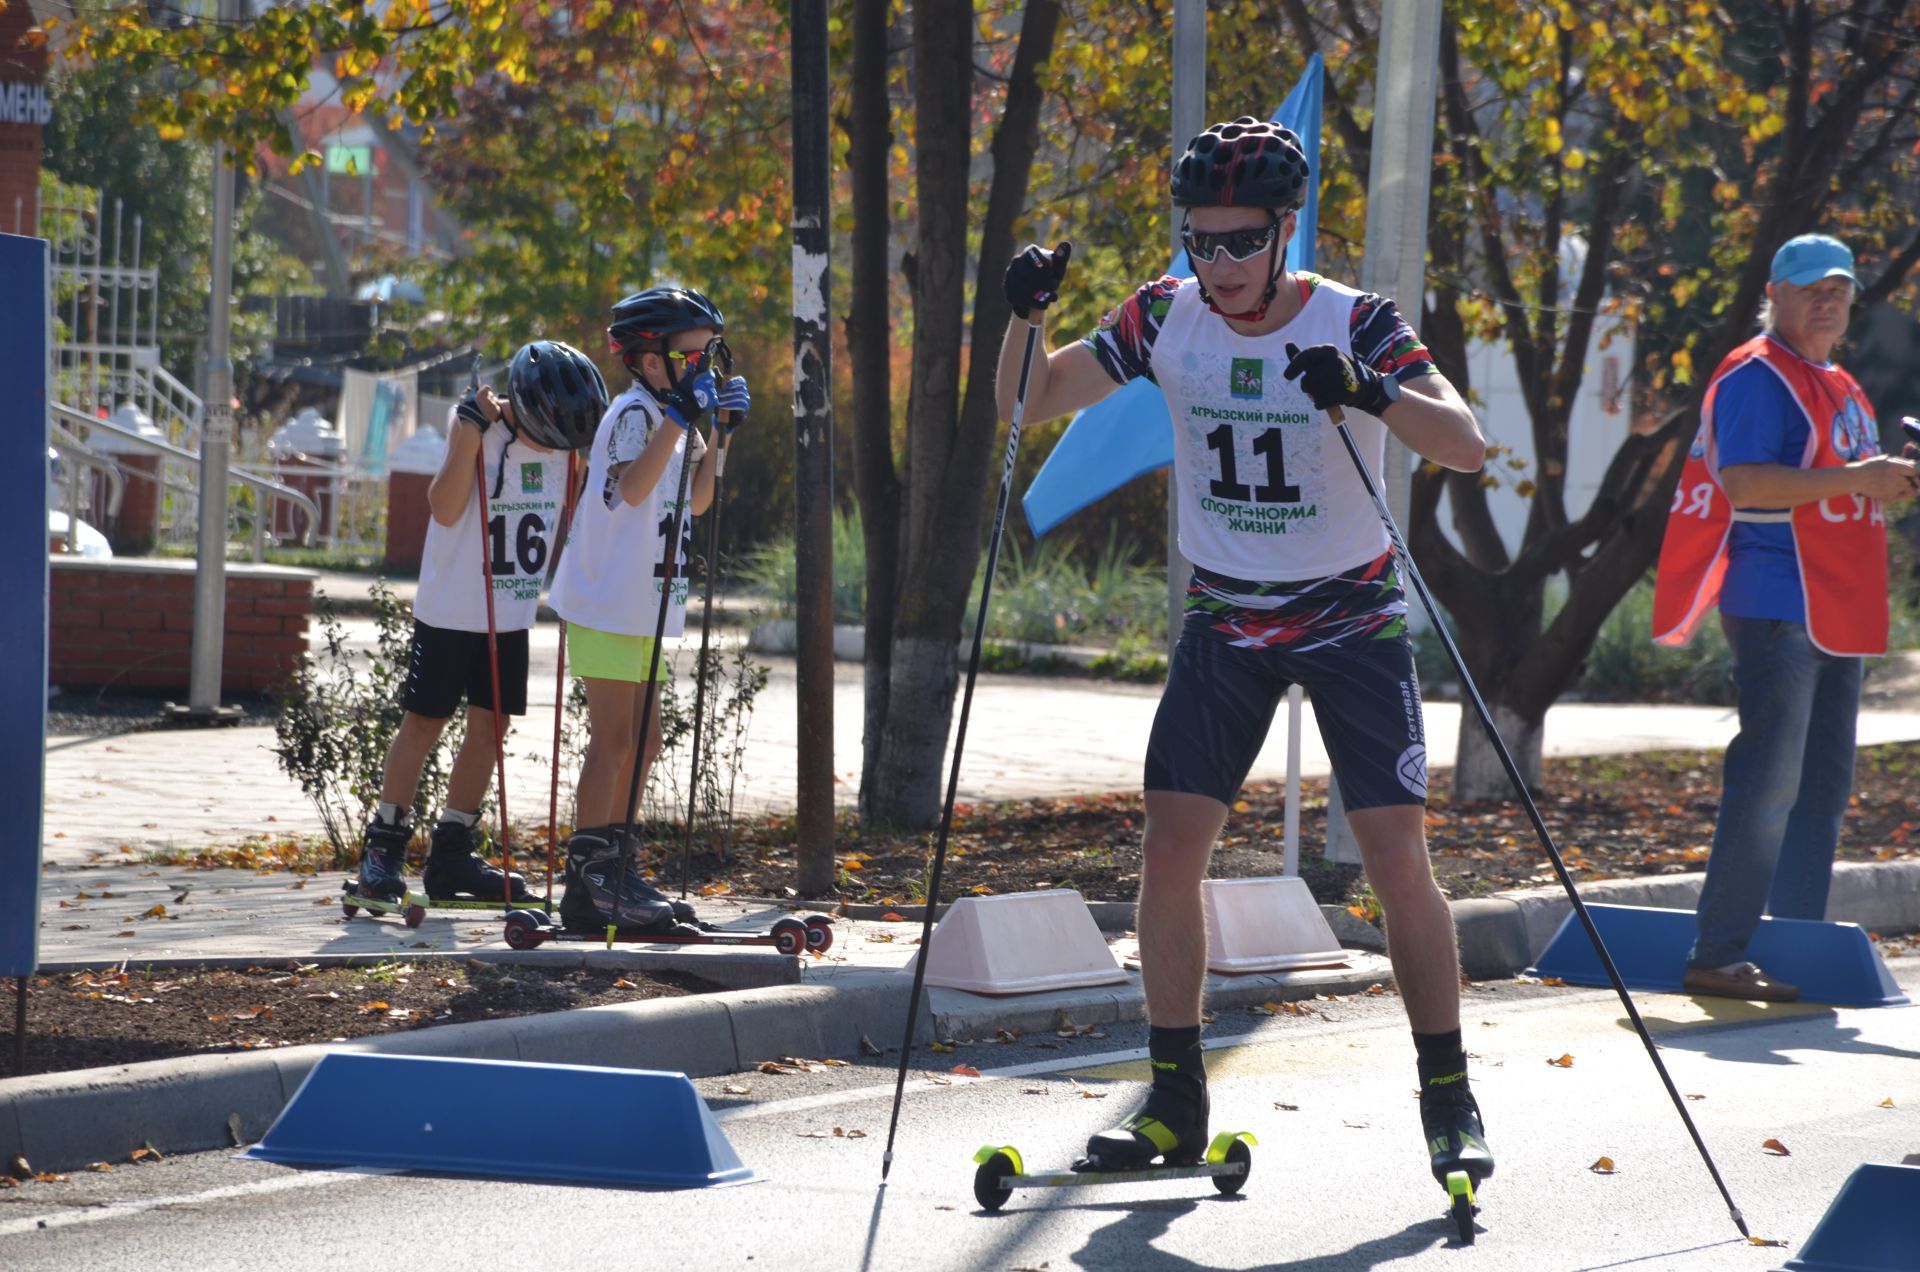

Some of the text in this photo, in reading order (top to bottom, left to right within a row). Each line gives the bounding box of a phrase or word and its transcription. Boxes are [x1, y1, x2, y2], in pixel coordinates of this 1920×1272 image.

[1191, 405, 1309, 424] АГРЫЗСКИЙ РАЙОН
[1206, 423, 1301, 503] 11
[483, 512, 547, 575] 16
[1228, 518, 1287, 534] ЖИЗНИ
[1400, 682, 1418, 741] Сетевая
